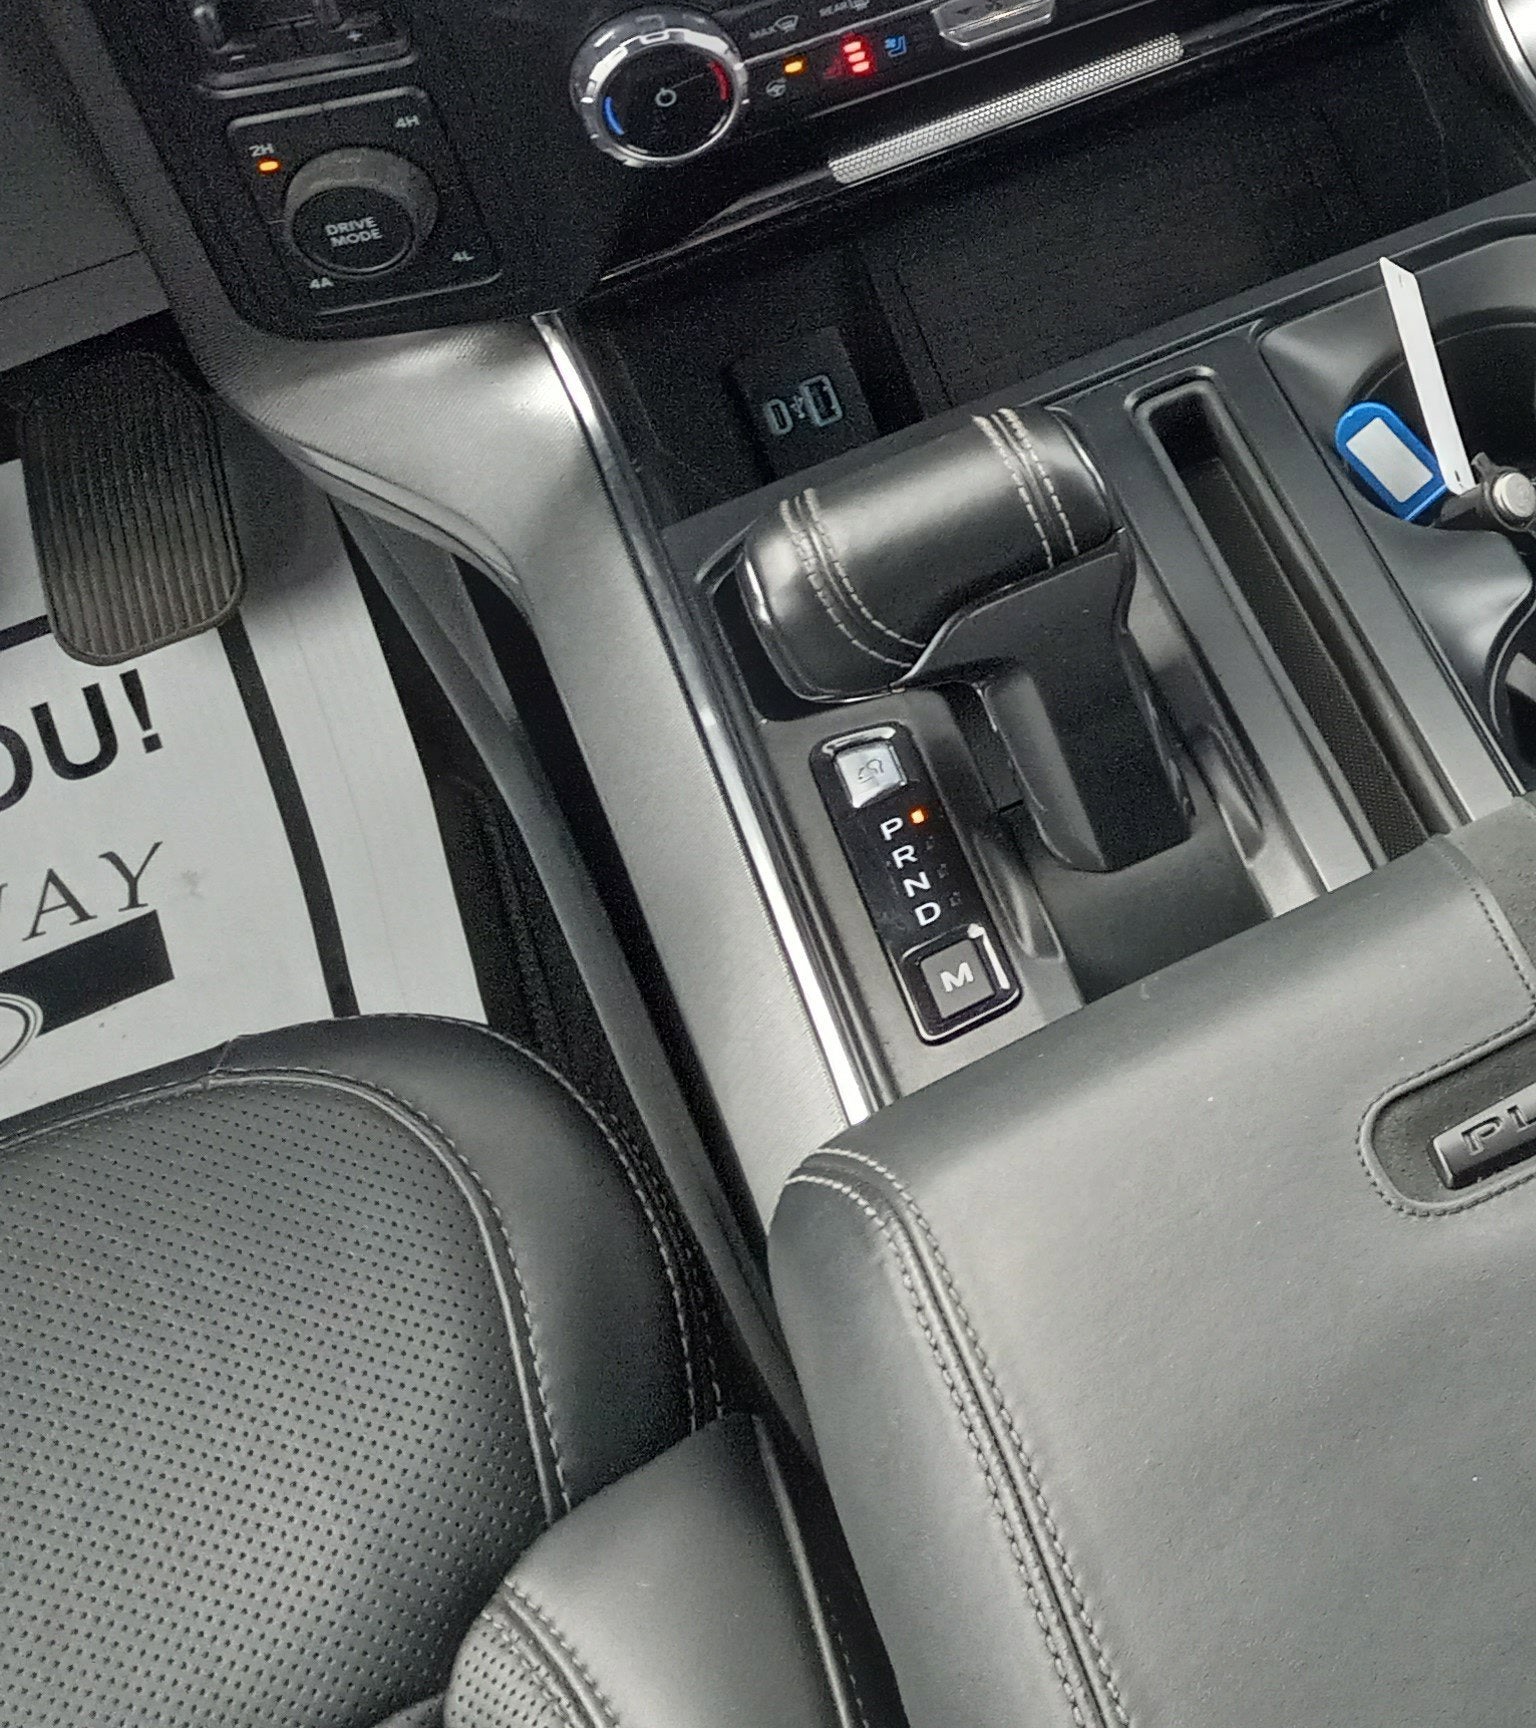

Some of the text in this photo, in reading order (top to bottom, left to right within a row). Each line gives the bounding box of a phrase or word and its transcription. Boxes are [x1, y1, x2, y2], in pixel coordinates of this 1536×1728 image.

[395, 114, 421, 130] 4H
[249, 143, 275, 158] 2H
[325, 215, 379, 236] DRIVE
[330, 228, 383, 248] MODE
[451, 250, 475, 262] 4L
[309, 276, 334, 290] 4A
[880, 817, 903, 841] P
[891, 844, 918, 869] R
[0, 841, 163, 941] AY
[903, 871, 931, 898] N
[914, 901, 941, 926] D
[940, 961, 974, 993] M
